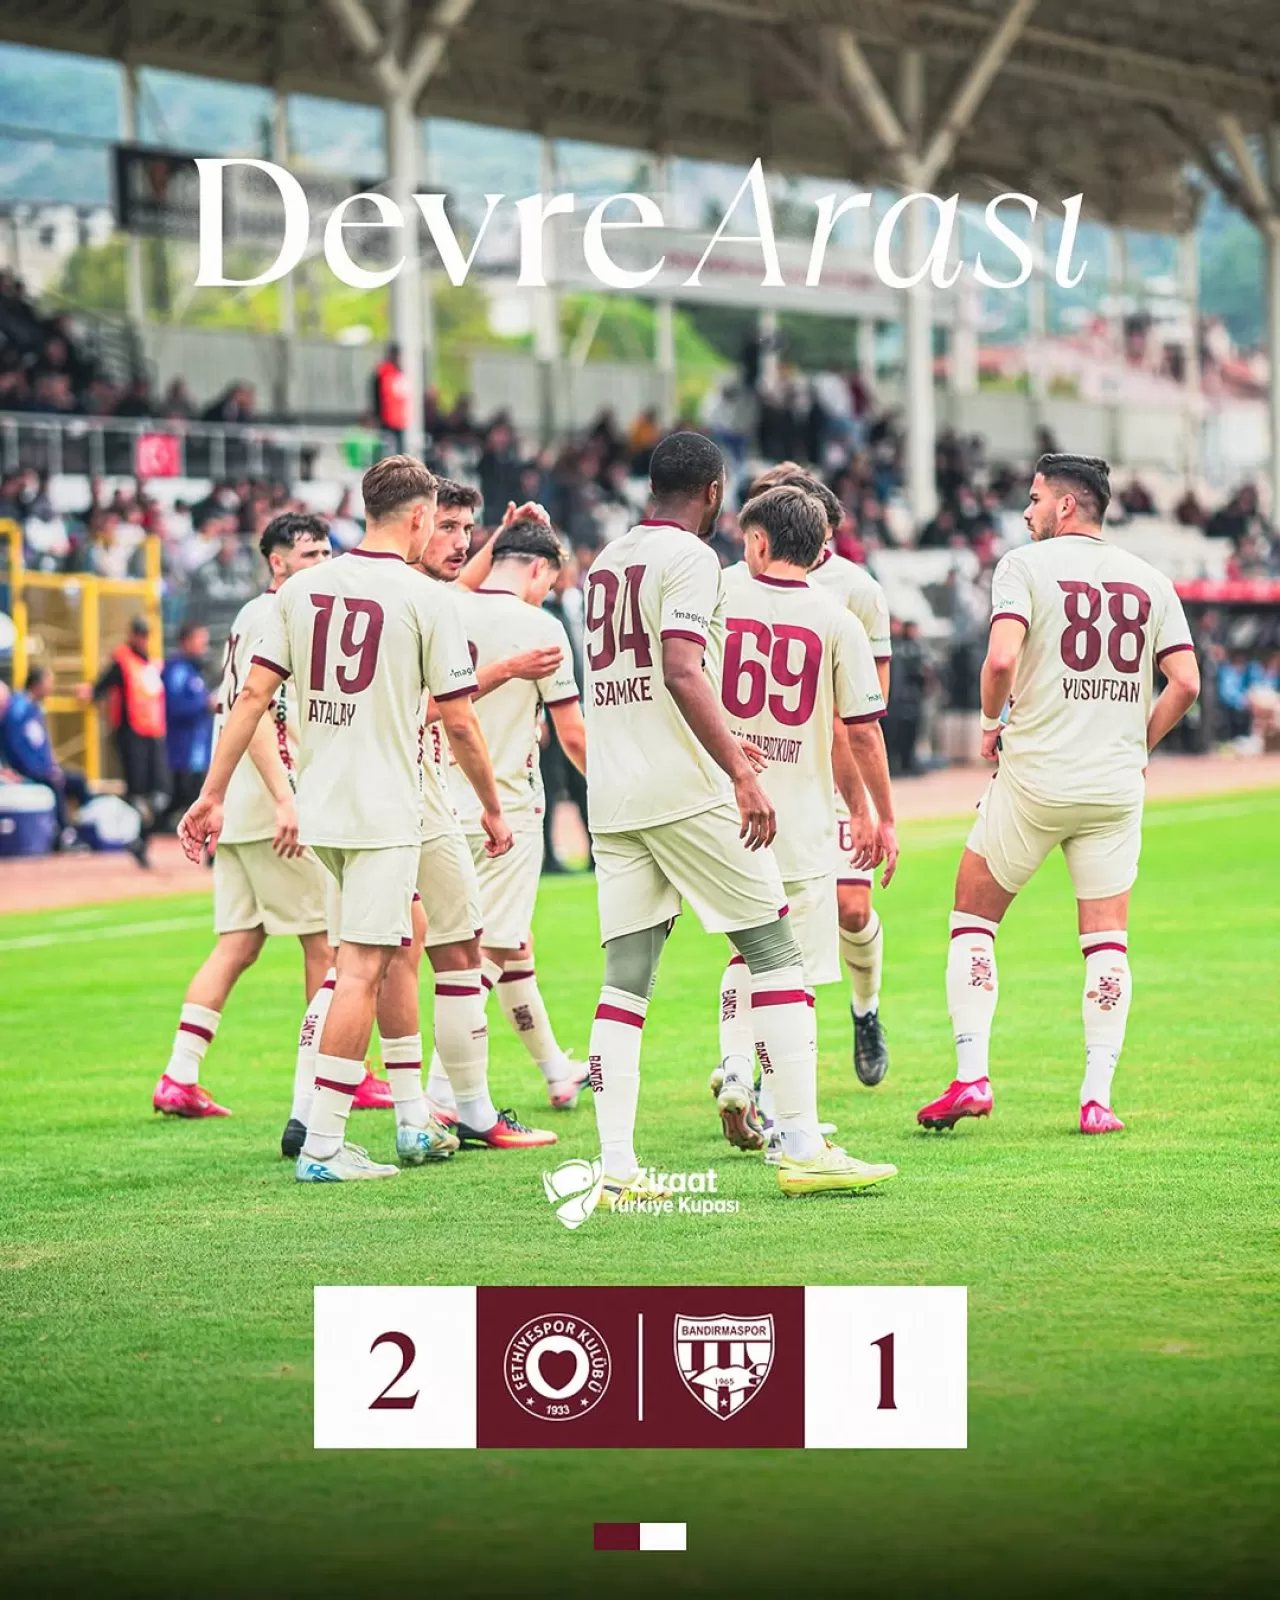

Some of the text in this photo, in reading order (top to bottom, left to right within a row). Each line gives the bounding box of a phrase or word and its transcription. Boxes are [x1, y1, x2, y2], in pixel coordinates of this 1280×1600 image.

[309, 593, 384, 695] 19
[586, 564, 653, 672] 94
[1057, 580, 1151, 674] 88
[308, 699, 356, 727] ATALAY
[721, 617, 823, 726] 69
[1062, 678, 1140, 703] YUSUFCAN
